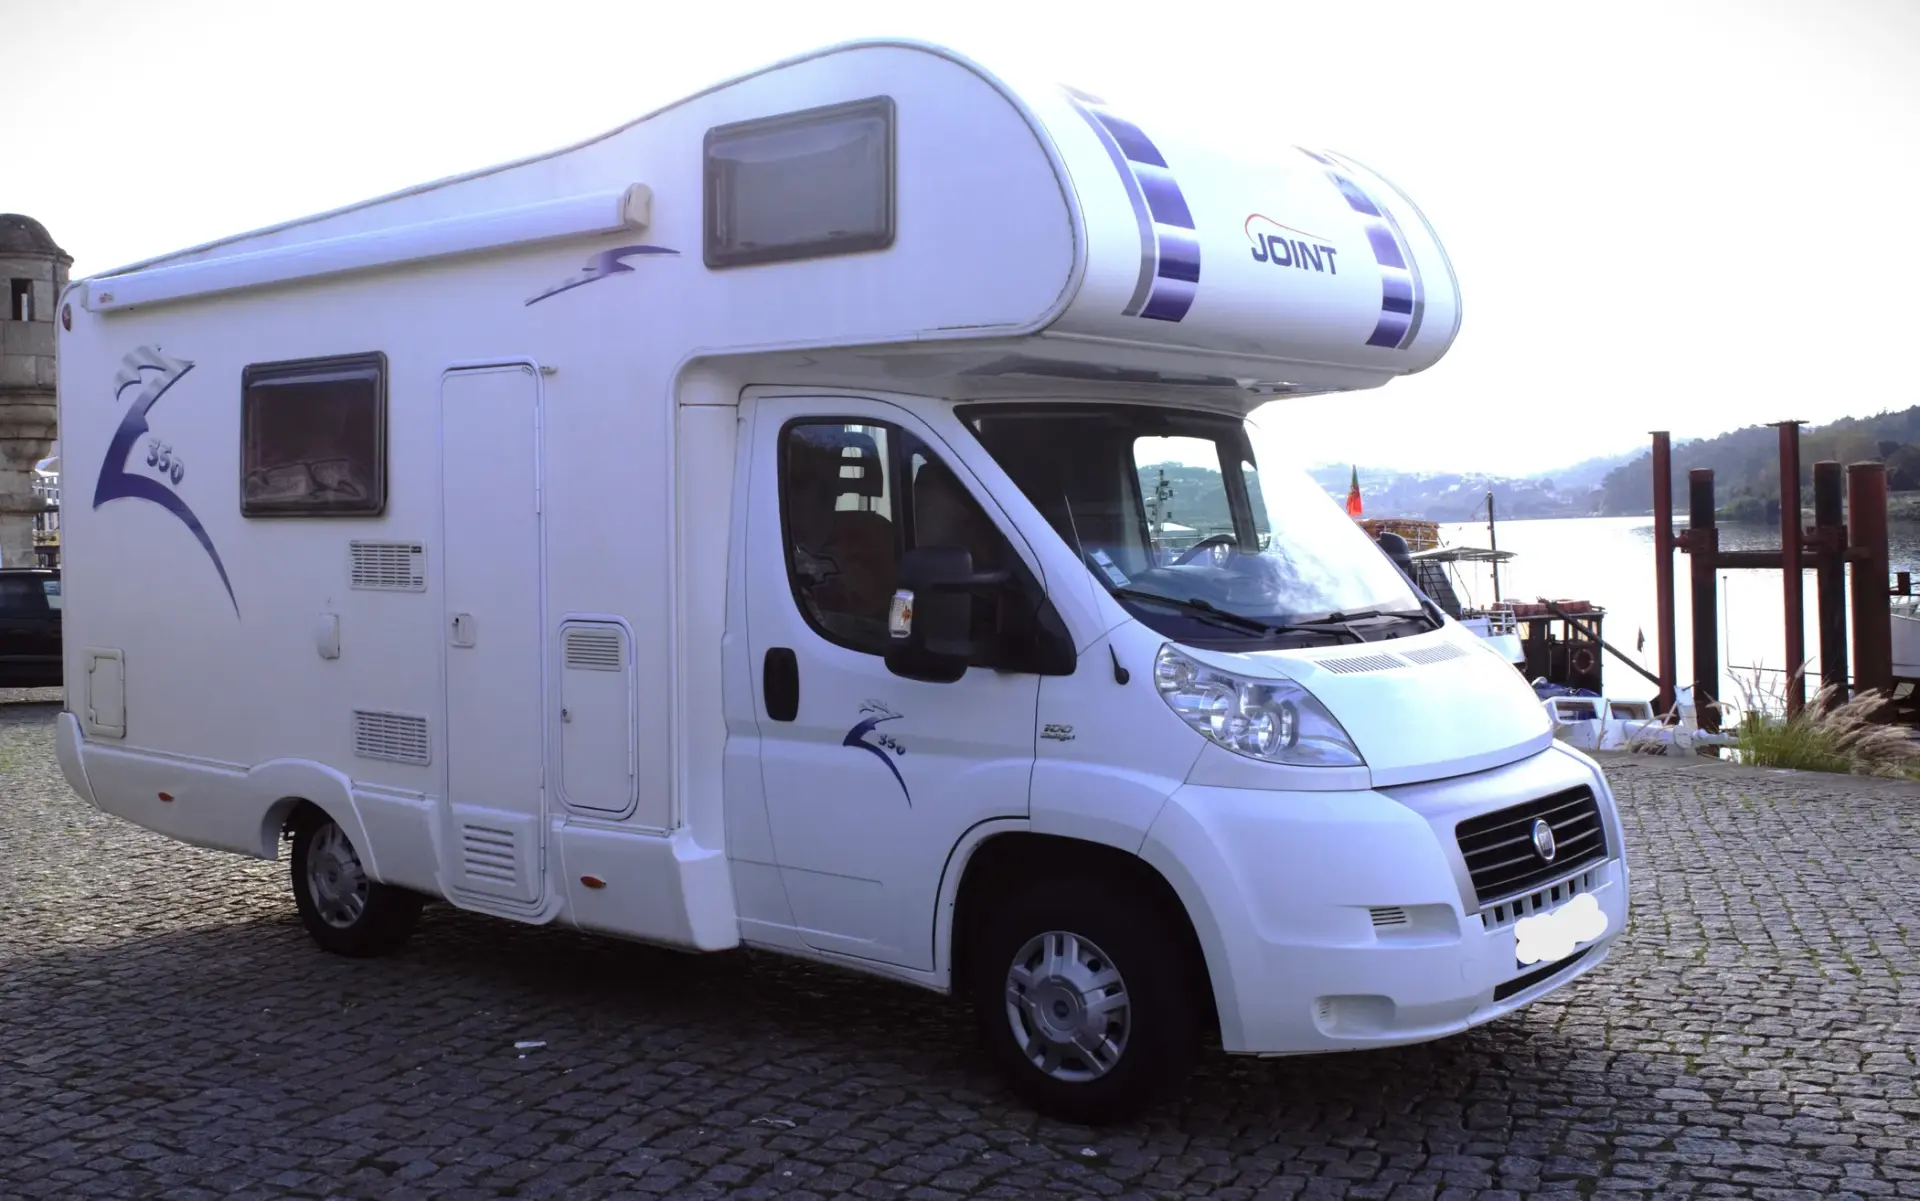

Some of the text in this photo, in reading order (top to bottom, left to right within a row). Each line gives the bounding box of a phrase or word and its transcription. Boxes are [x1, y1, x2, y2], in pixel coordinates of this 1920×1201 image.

[1251, 232, 1337, 275] JOINT
[146, 439, 185, 486] 350
[878, 733, 906, 756] 350
